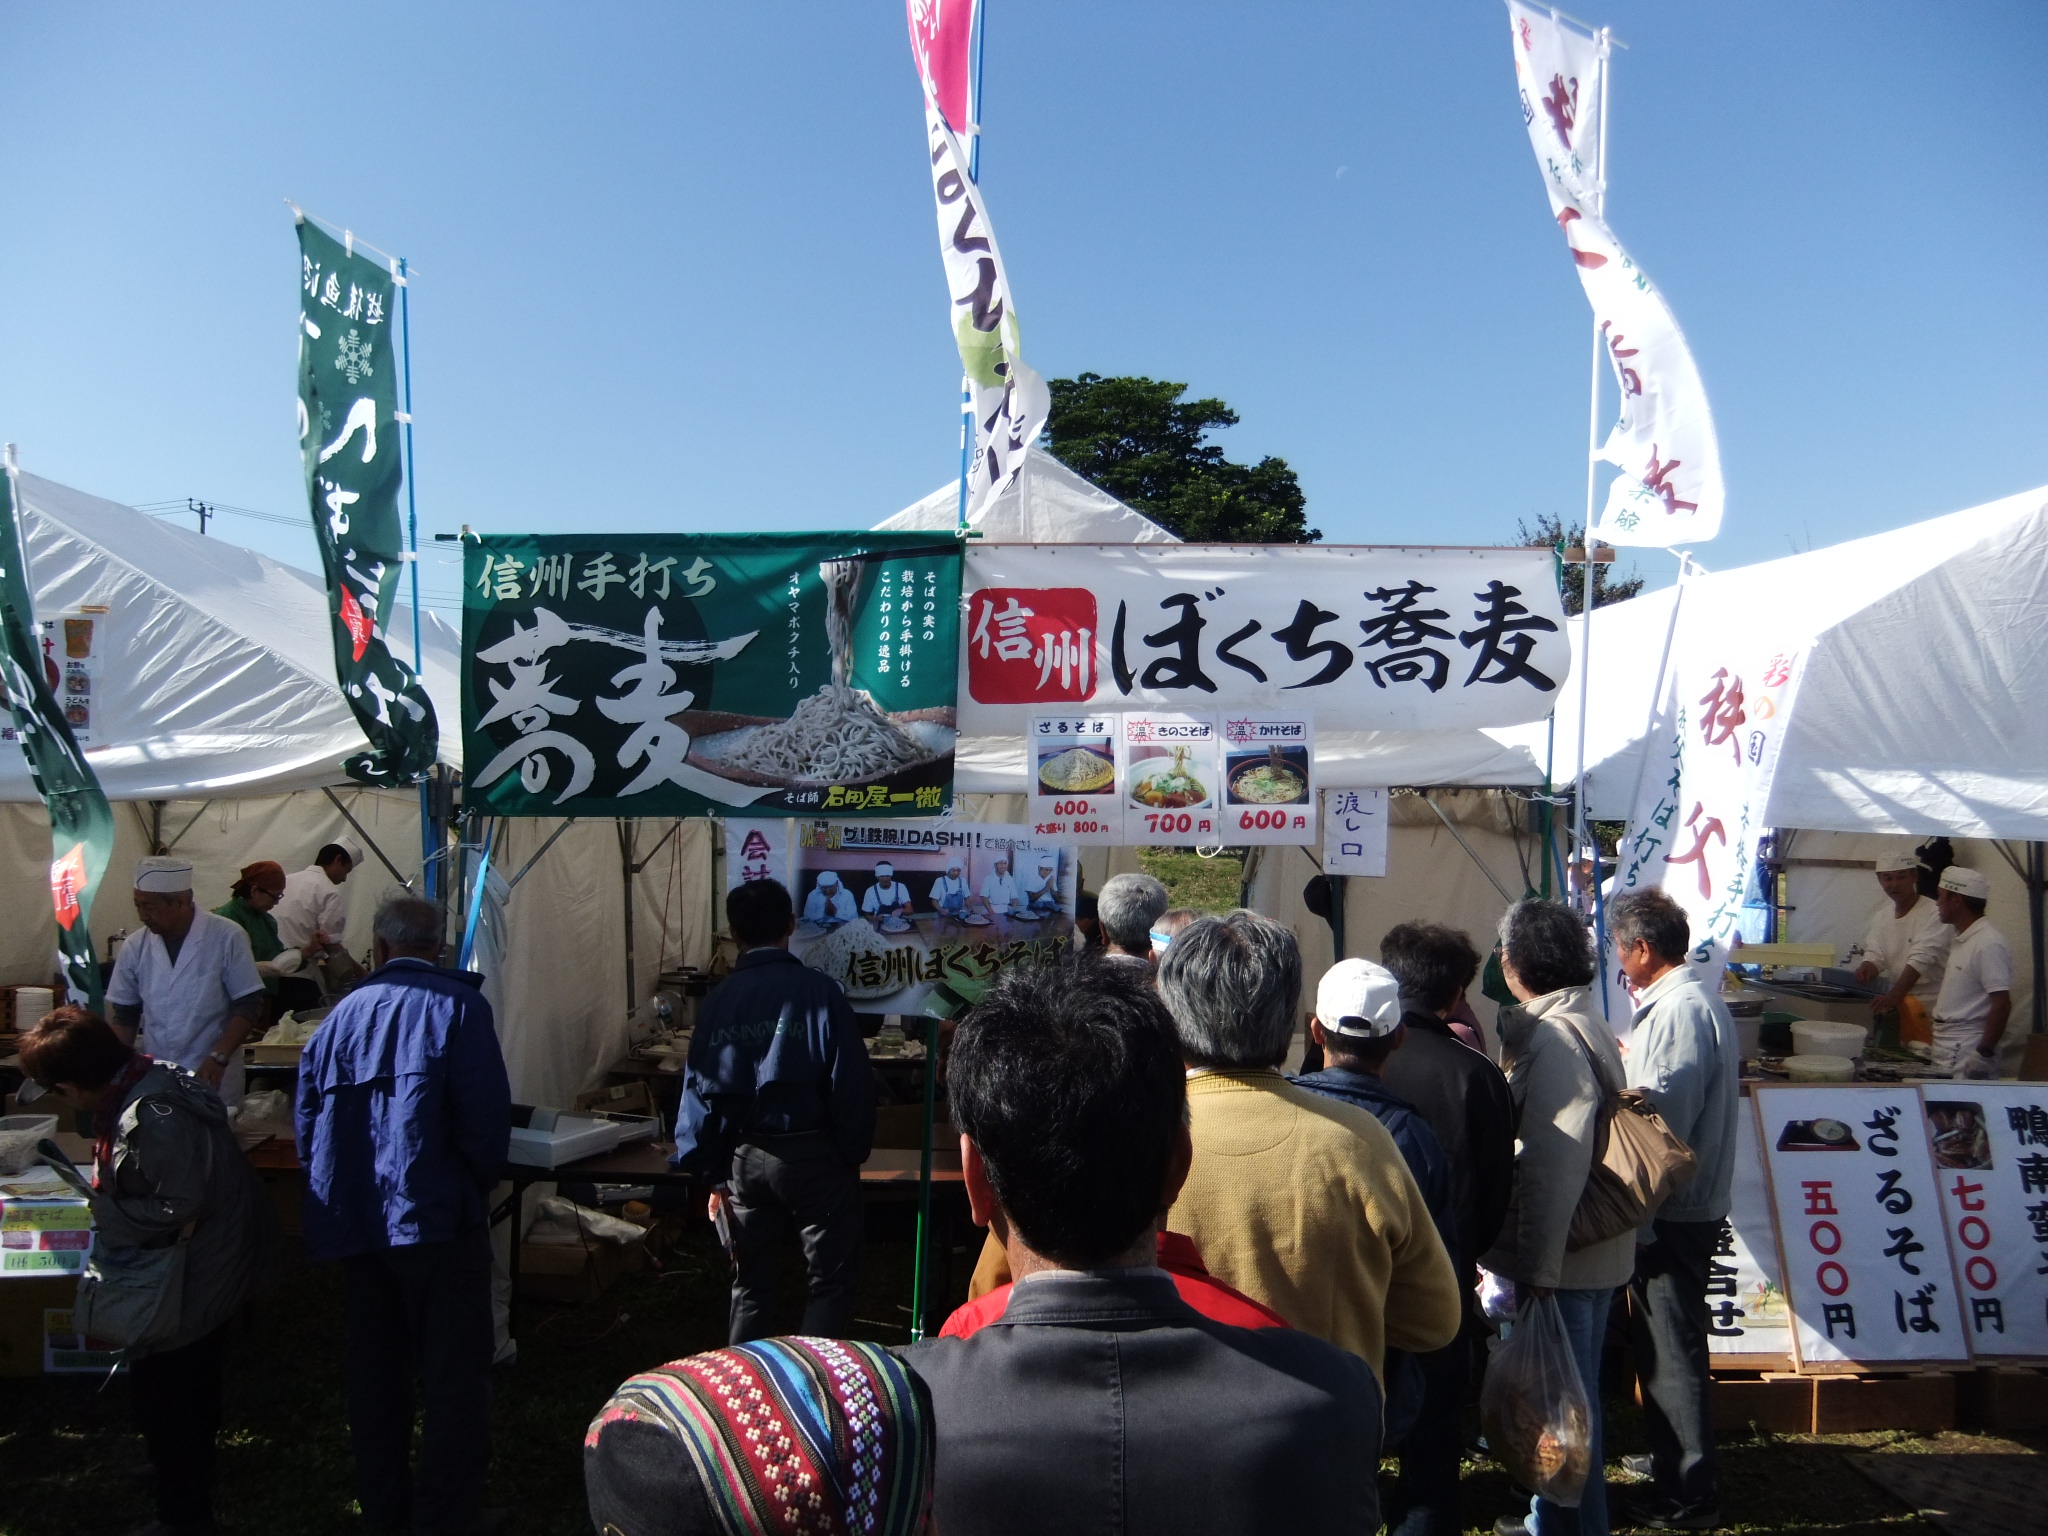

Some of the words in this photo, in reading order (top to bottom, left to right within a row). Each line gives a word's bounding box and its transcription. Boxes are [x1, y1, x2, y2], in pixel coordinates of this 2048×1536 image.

[476, 553, 717, 602] 信州手打ち
[922, 571, 936, 641] そばの実の
[787, 571, 801, 689] オヤマボクチ入り
[877, 571, 892, 674] こだわりの逸品
[899, 570, 915, 688] 栽培から手掛ける
[970, 598, 1090, 697] 信州
[1110, 579, 1559, 696] ぼくち蕎麦
[471, 605, 785, 808] 蕎麦
[1038, 721, 1105, 734] ざるそば
[1158, 725, 1210, 738] きのこそば
[1259, 724, 1302, 737] かけそば
[784, 791, 819, 804] そば師
[822, 785, 942, 810] 石田屋一徹
[1034, 822, 1066, 835] 大盛り
[849, 936, 1067, 987] 信州ぼくちそば
[1862, 1105, 1940, 1334] ざるそば
